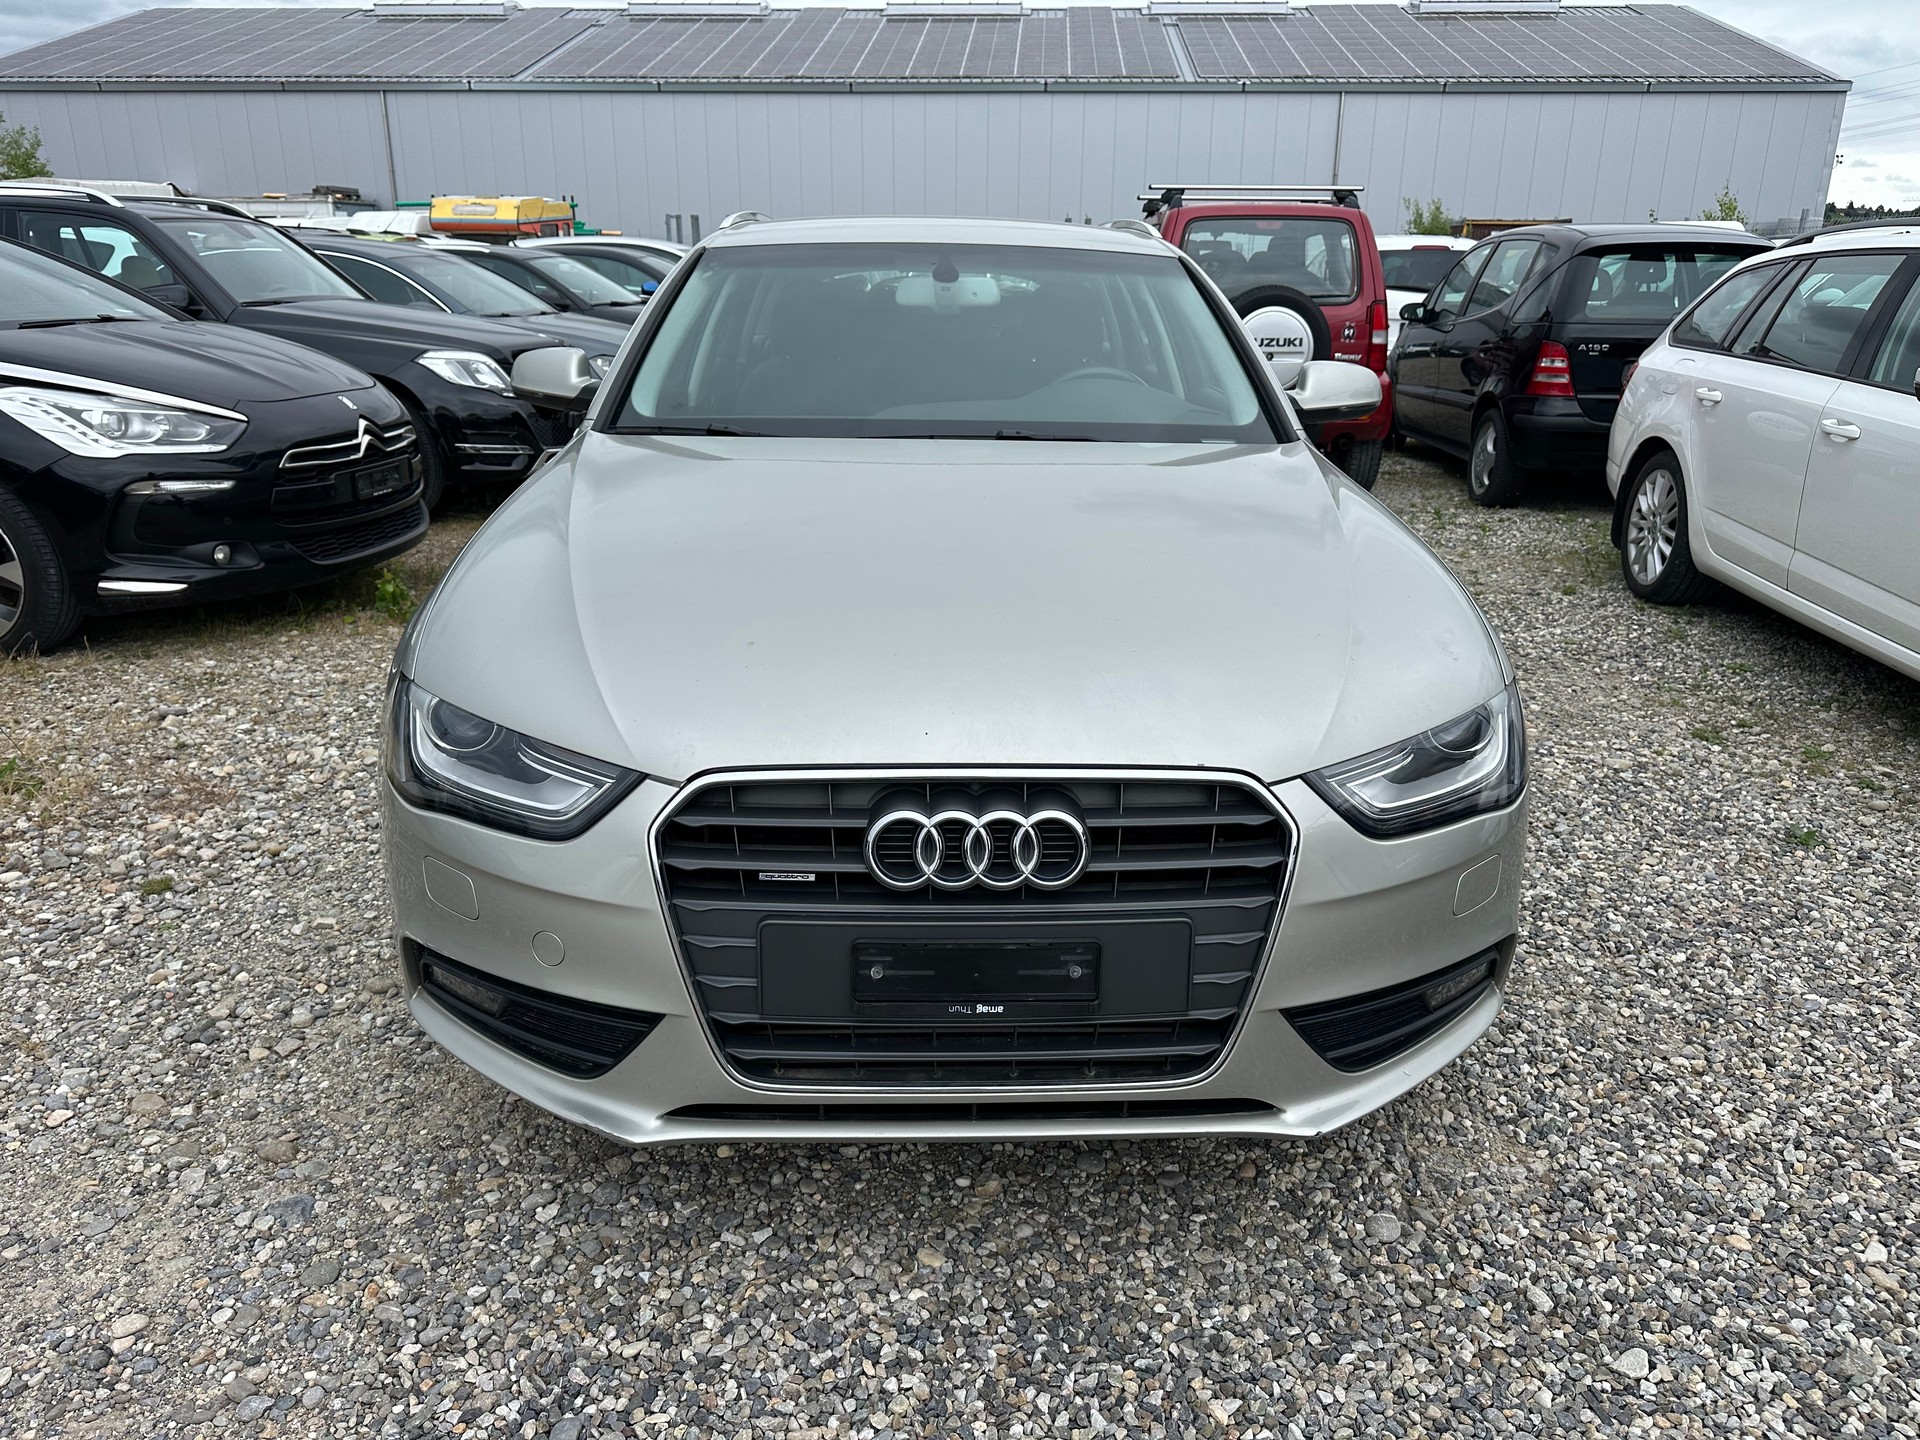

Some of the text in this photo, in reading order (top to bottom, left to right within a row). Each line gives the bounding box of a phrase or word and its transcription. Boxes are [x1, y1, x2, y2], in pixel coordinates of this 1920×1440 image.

[1254, 337, 1303, 347] UZUKI
[948, 1004, 1004, 1014] amag Thun
